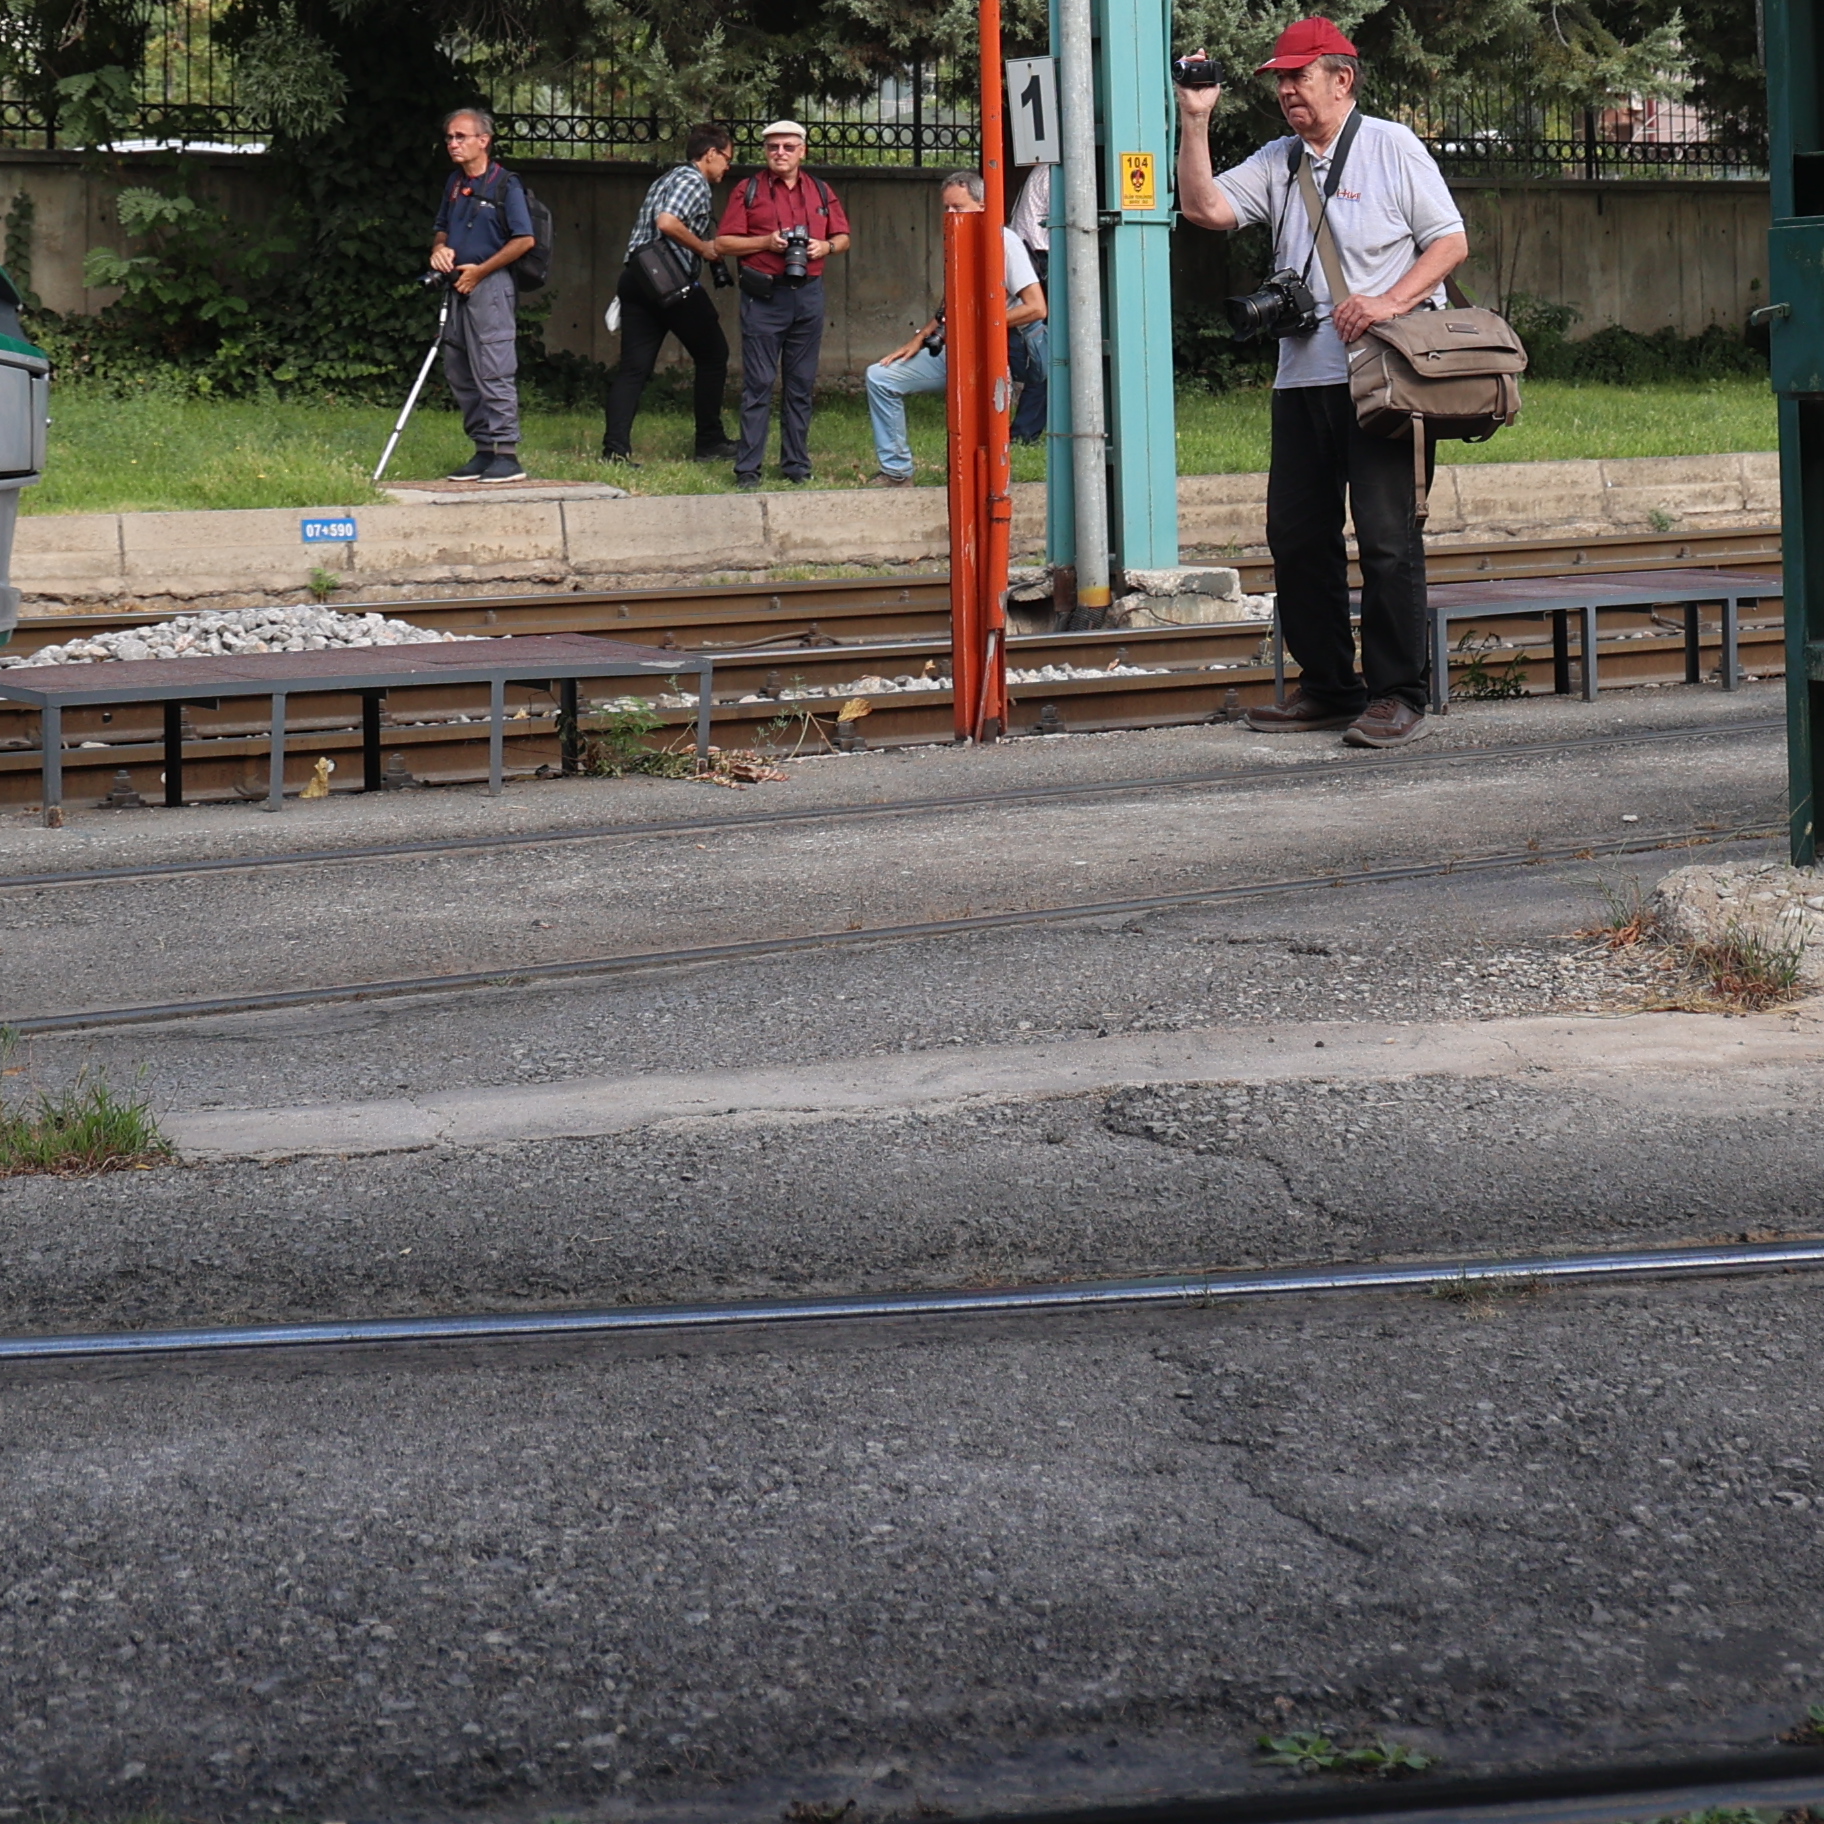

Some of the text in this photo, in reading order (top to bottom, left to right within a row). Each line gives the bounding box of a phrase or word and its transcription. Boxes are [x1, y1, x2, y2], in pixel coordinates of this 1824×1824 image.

[1021, 75, 1046, 142] 1
[1127, 157, 1149, 169] 104
[306, 523, 354, 537] 07+590
